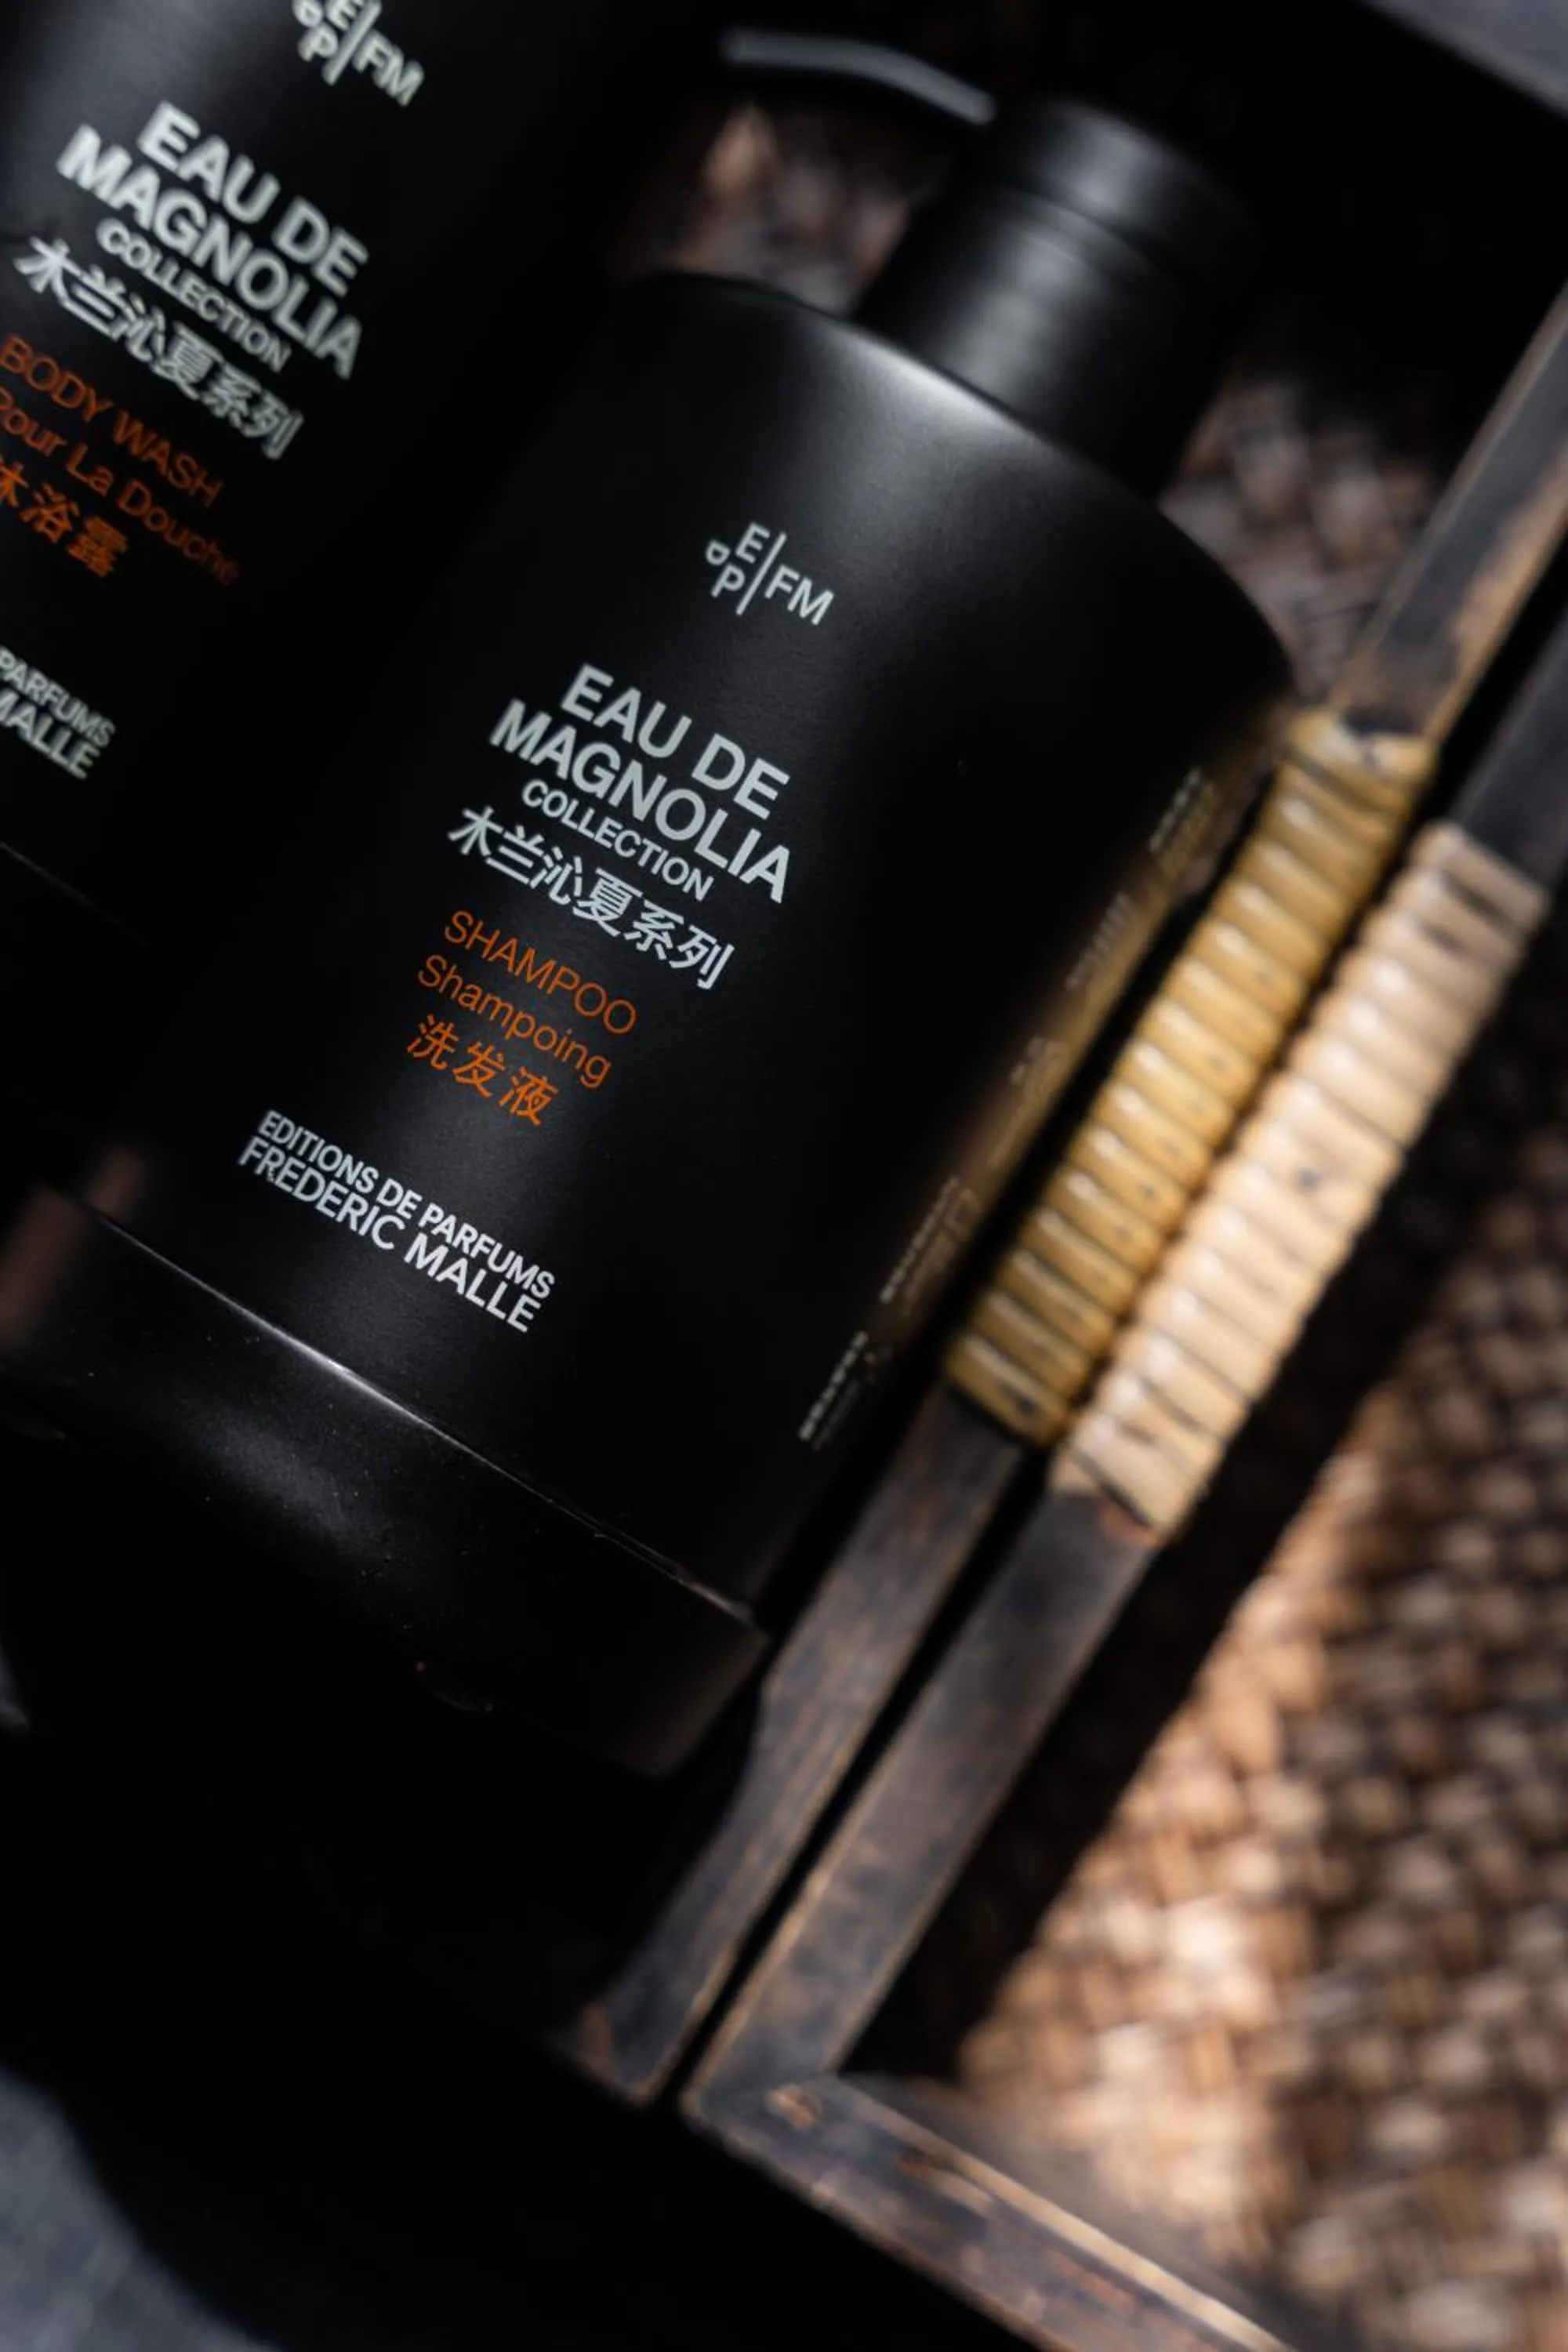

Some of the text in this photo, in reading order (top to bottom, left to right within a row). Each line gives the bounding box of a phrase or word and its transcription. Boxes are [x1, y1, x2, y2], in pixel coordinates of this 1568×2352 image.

[56, 124, 361, 379] MAGNOLIA
[136, 100, 369, 297] EAU DE
[13, 237, 304, 459] 木兰沁夏系列
[96, 217, 291, 372] COLLECTION
[0, 335, 224, 508] BODY WASH
[66, 441, 114, 497] La
[117, 479, 245, 585] Douche
[489, 698, 791, 905] MAGNOLIA
[561, 663, 790, 821] EAU DE
[448, 806, 735, 990] 木兰沁夏系列
[521, 780, 713, 902] COLLECTION
[418, 955, 612, 1090] Shampoing
[444, 910, 637, 1035] SHAMPOO
[406, 1015, 559, 1126] 洗发液
[238, 1135, 543, 1333] FREDERIC MALLE
[258, 1109, 556, 1300] EDITIONS DE PARFUMS
